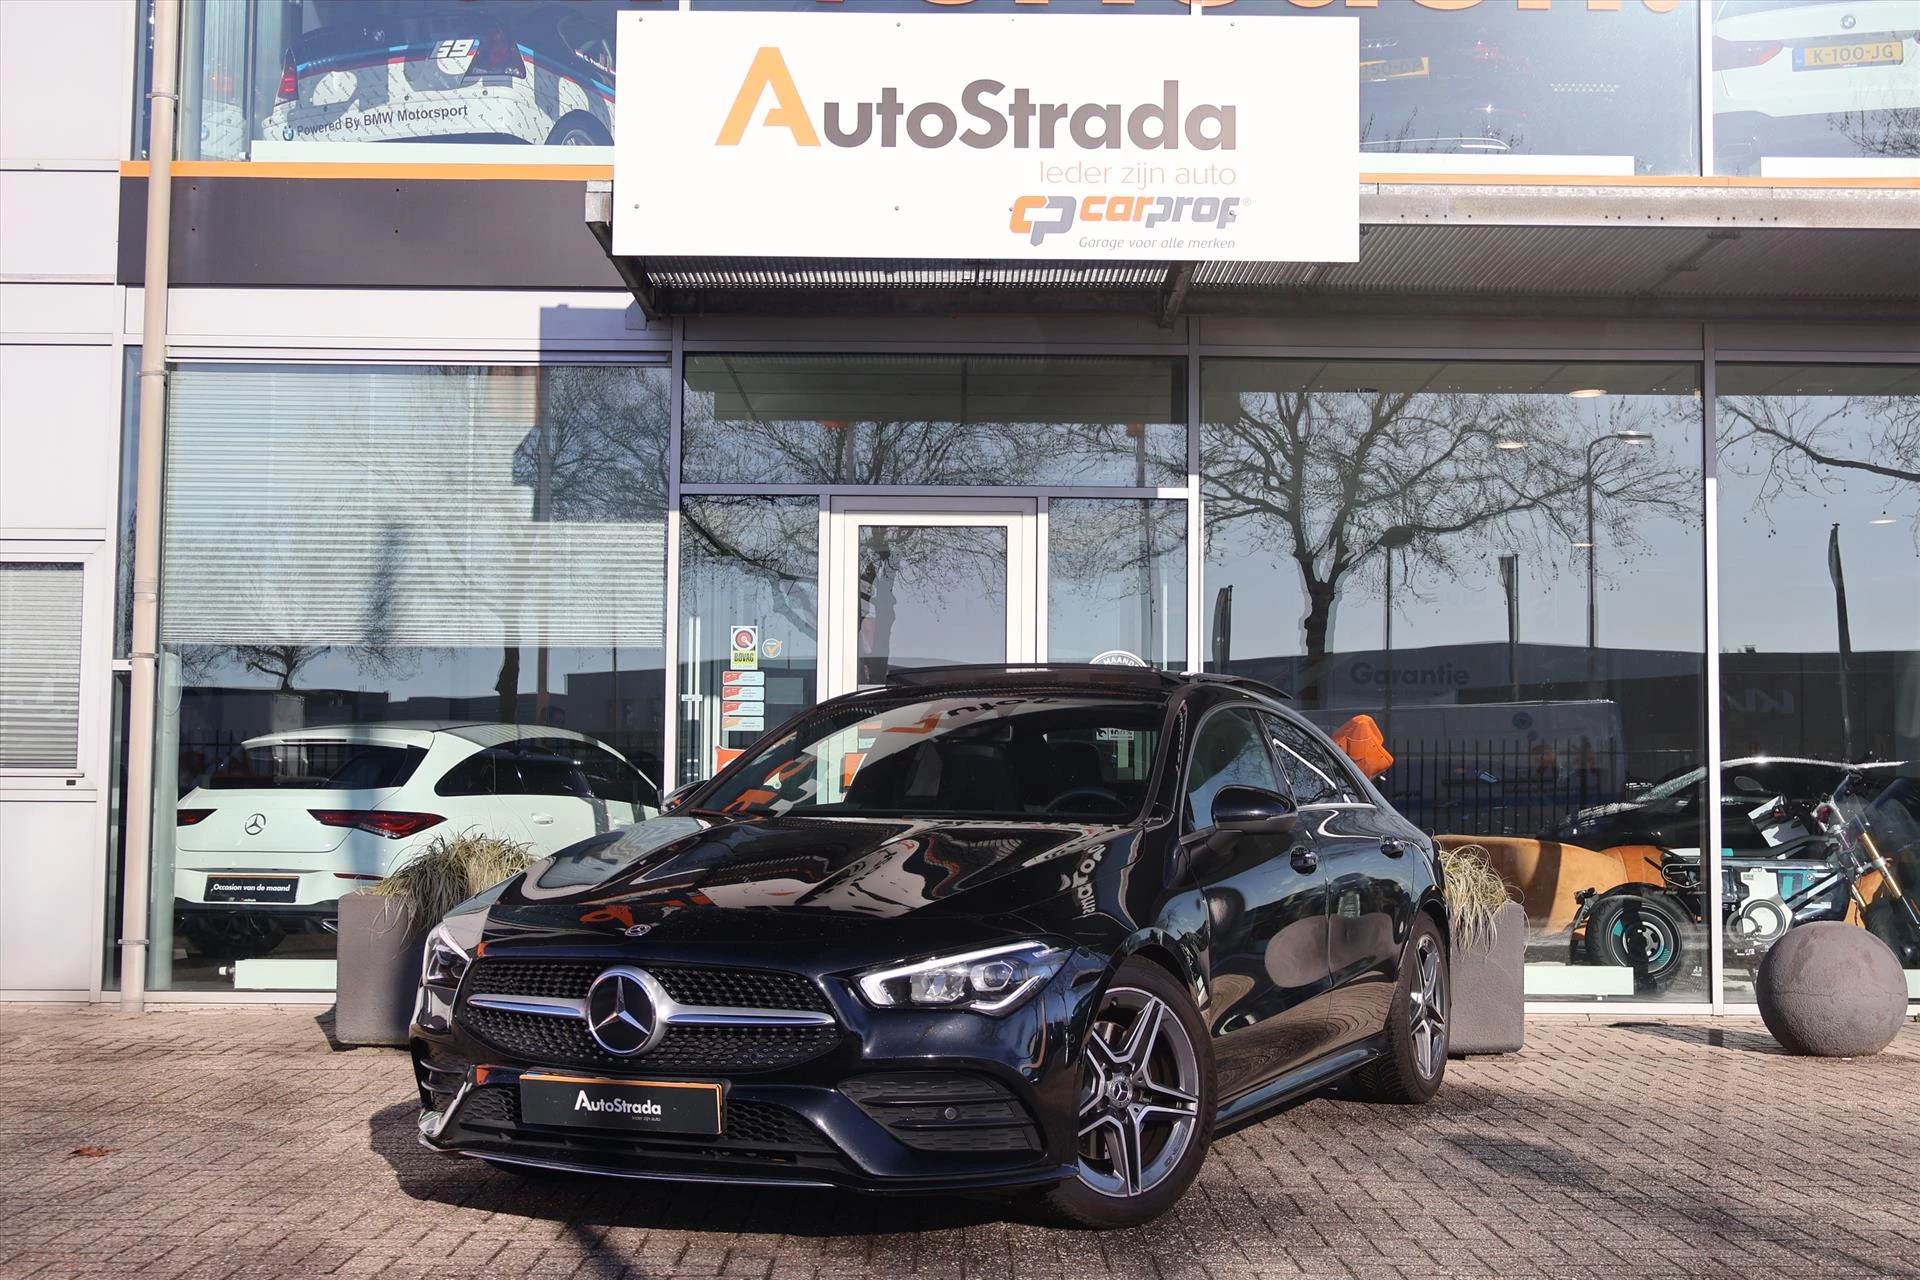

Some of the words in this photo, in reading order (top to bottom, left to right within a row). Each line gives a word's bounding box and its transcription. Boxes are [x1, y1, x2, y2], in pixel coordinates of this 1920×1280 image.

[1813, 44, 1893, 63] K-100-JG
[714, 47, 1236, 151] AutoStrada
[297, 118, 342, 137] Powered
[345, 117, 360, 130] By
[364, 112, 394, 126] BMW
[397, 104, 468, 122] Motorsport
[1040, 160, 1109, 184] Ieder
[1121, 162, 1165, 190] zijn
[1175, 163, 1237, 185] auto
[1079, 195, 1240, 229] carprof
[1079, 236, 1124, 251] Garage
[1129, 238, 1157, 249] voor
[1161, 237, 1184, 249] alle
[1188, 237, 1235, 249] merken
[1350, 662, 1470, 685] Garantie
[266, 884, 291, 892] maand
[574, 1090, 661, 1115] AutoStrada
